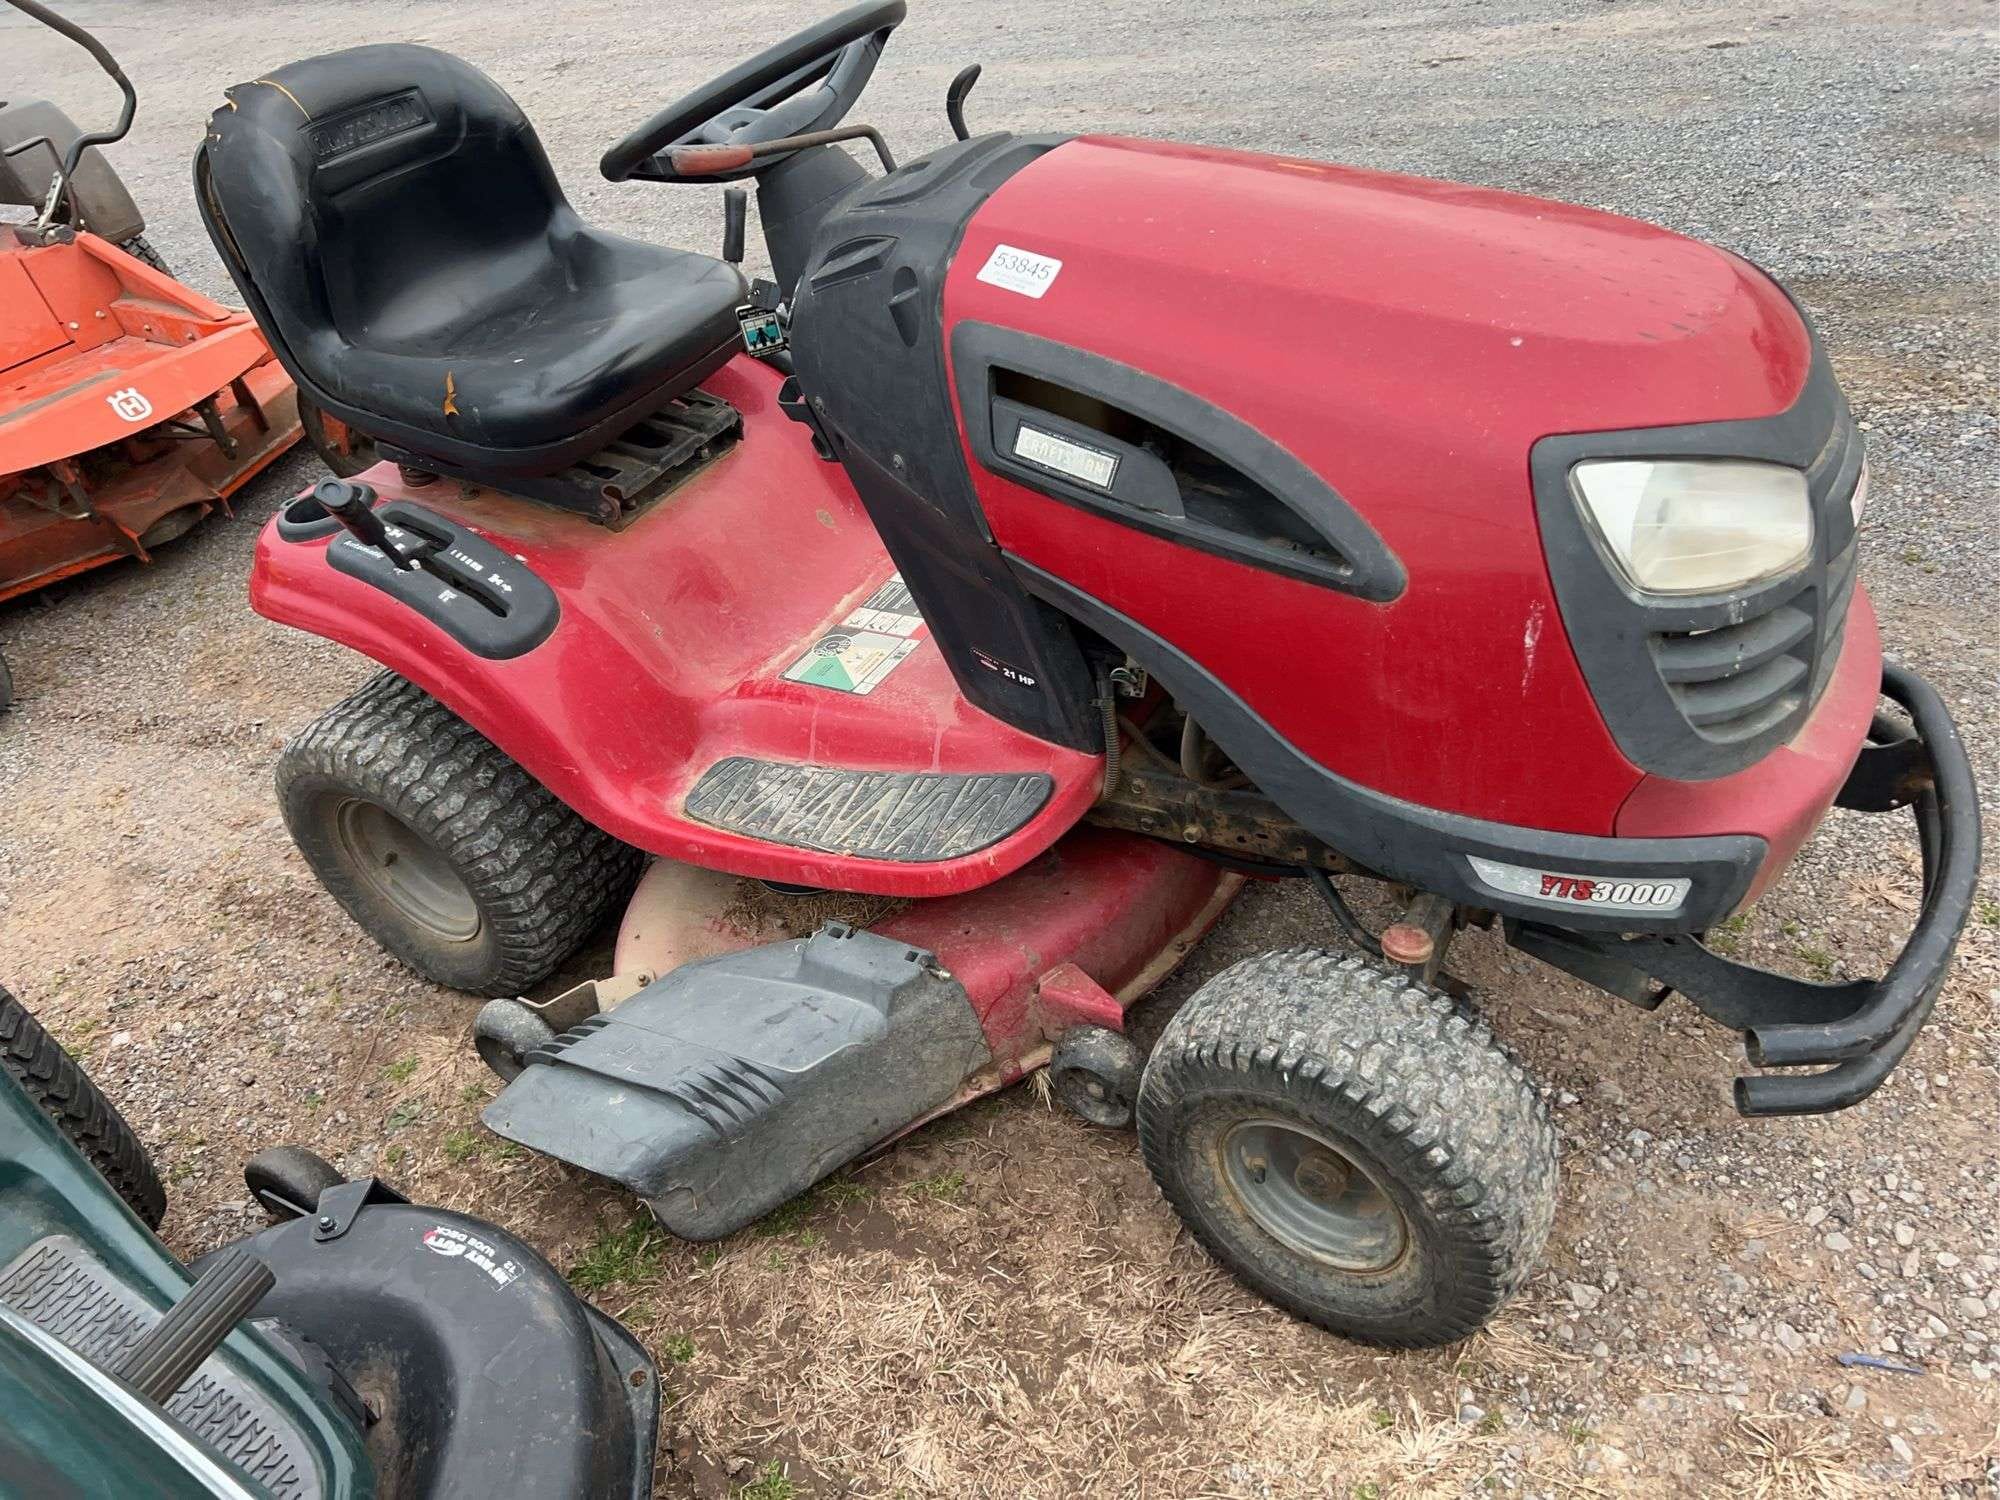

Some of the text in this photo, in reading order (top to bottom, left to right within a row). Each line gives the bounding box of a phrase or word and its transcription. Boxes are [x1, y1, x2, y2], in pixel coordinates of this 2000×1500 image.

[994, 252, 1052, 281] 53845
[1002, 667, 1035, 686] 21 HP
[1540, 873, 1677, 906] YTS3000
